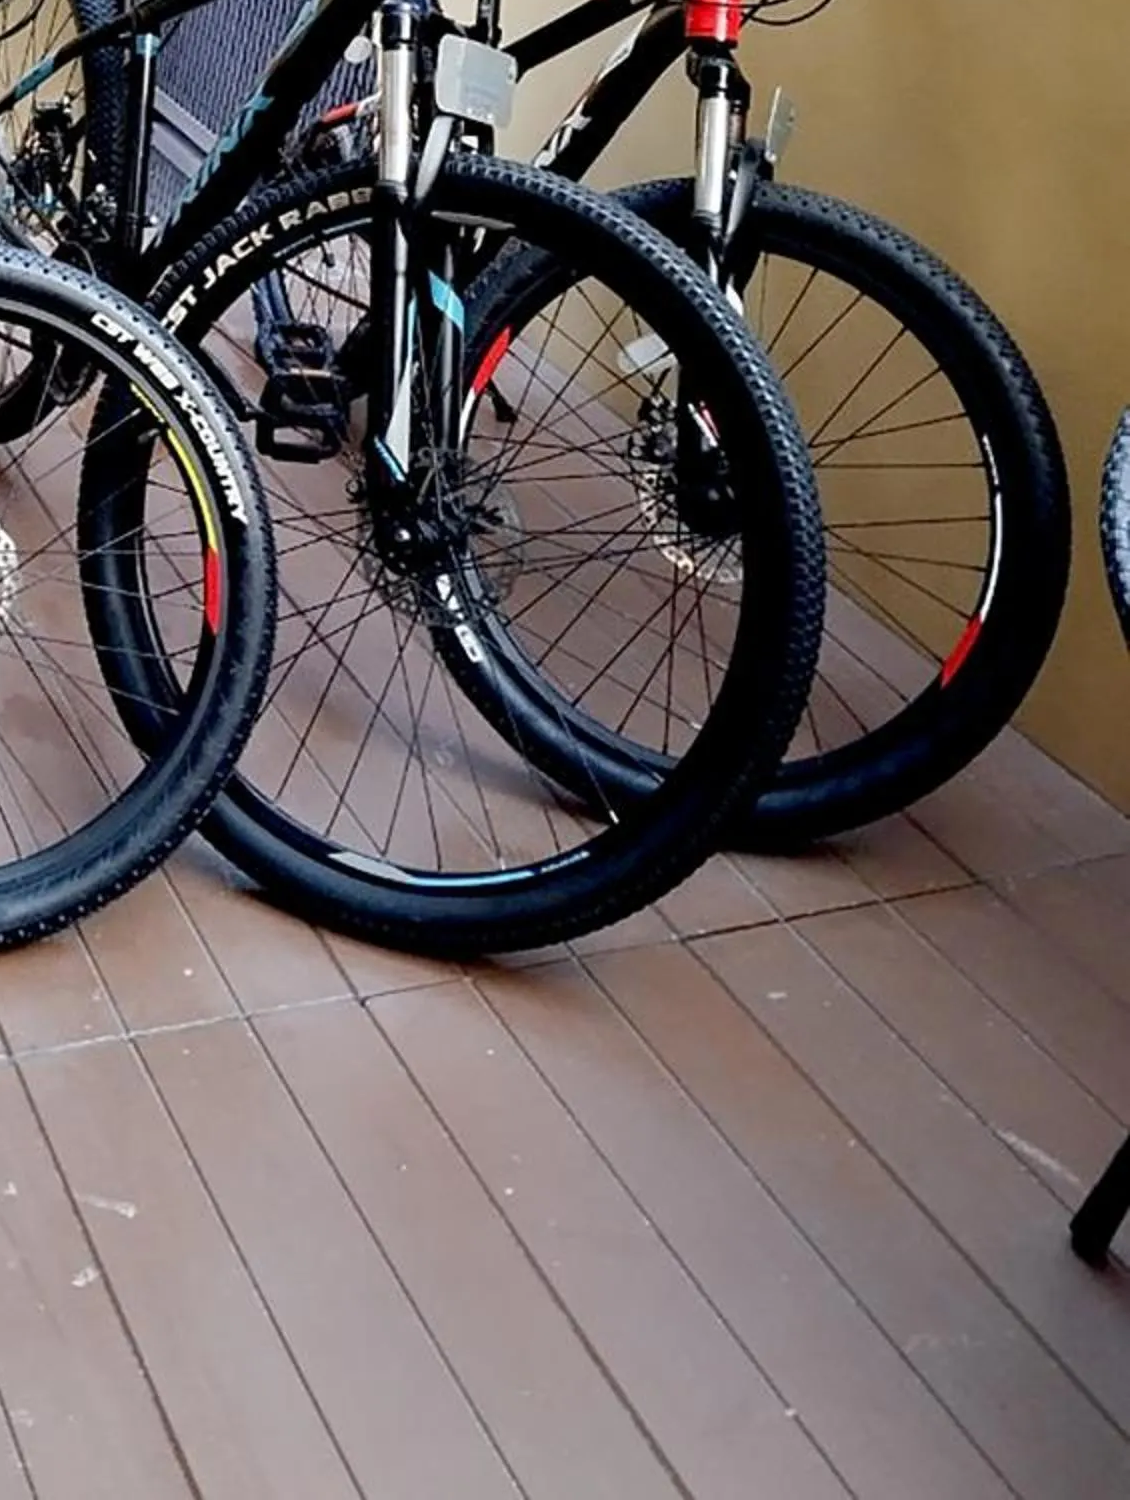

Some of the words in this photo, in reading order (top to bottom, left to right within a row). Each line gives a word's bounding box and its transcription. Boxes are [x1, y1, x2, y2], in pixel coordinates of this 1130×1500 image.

[202, 222, 274, 290] JACK
[278, 187, 373, 231] RABB
[90, 311, 136, 343] CST
[133, 342, 181, 390] WEB
[174, 390, 248, 525] X-COUNTRY
